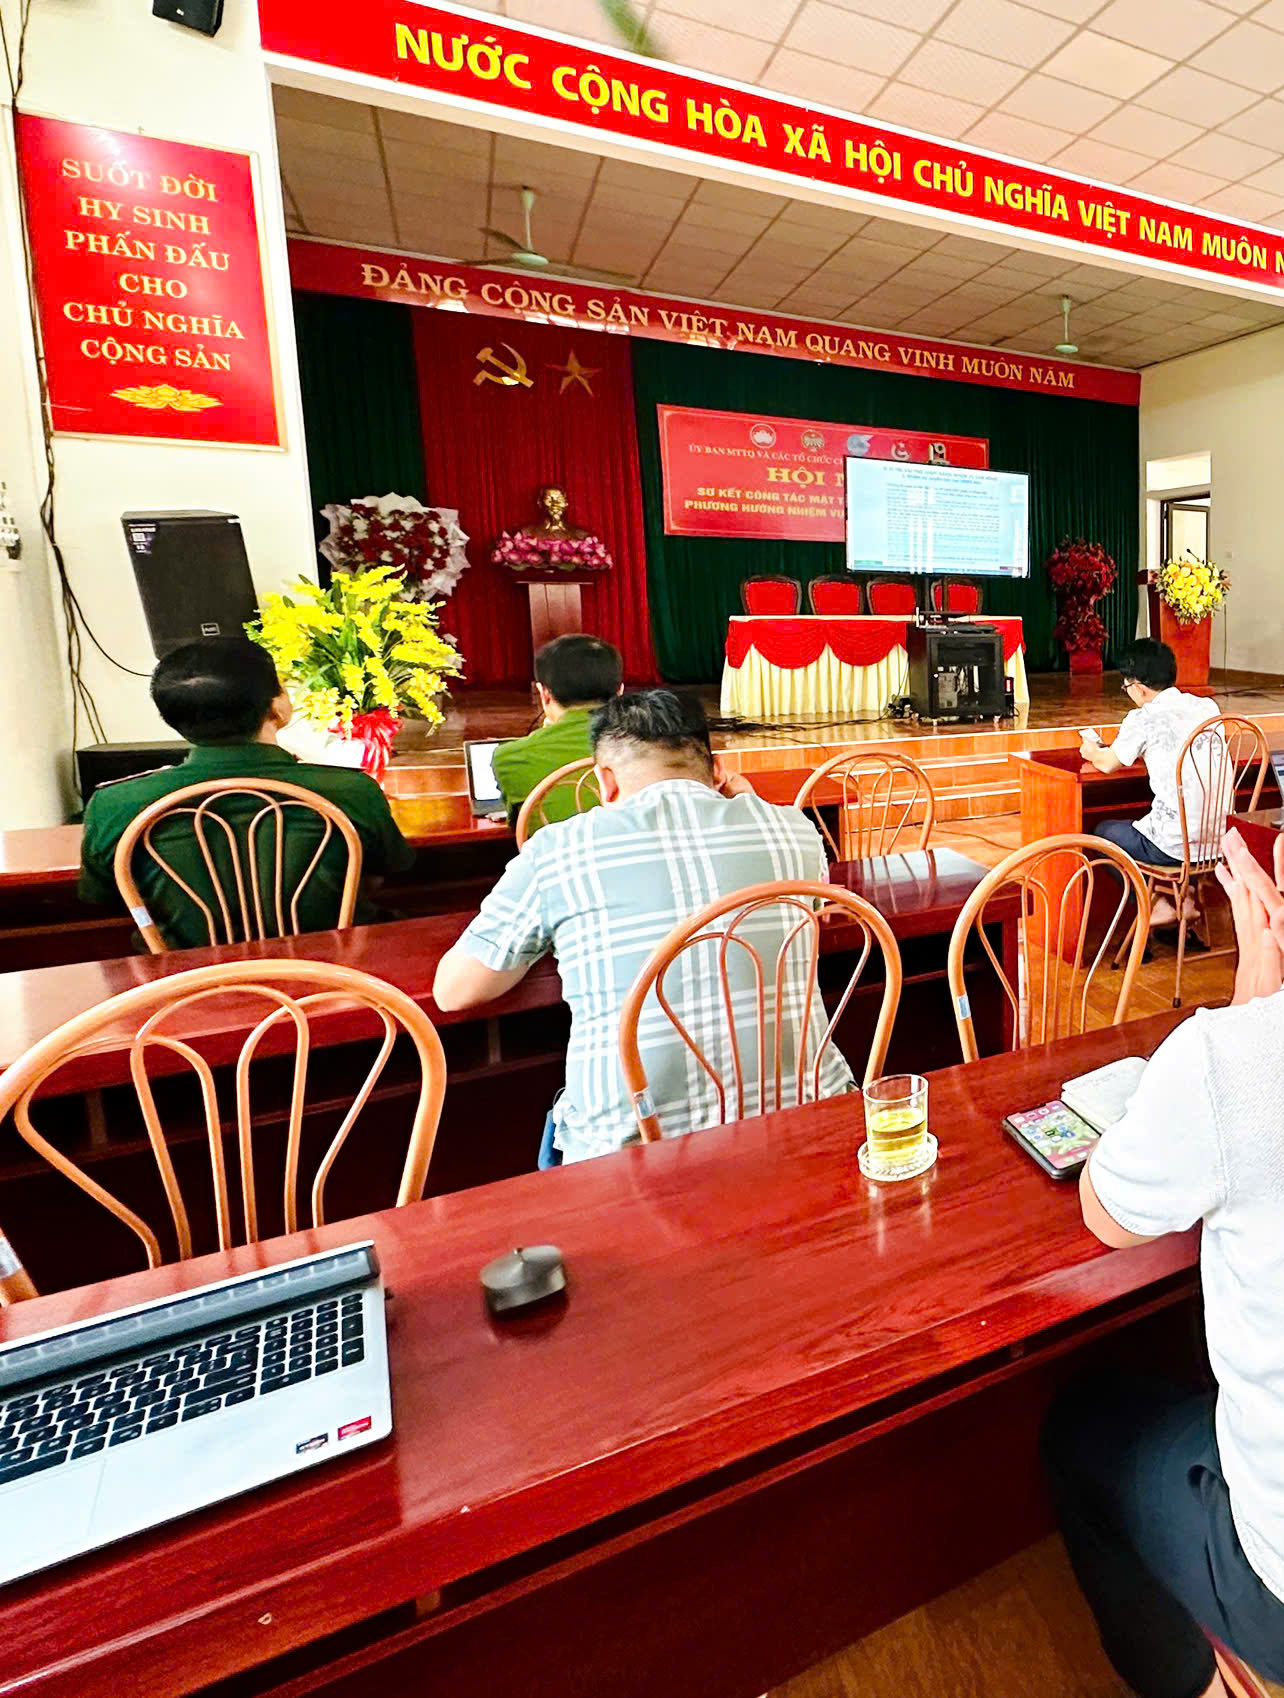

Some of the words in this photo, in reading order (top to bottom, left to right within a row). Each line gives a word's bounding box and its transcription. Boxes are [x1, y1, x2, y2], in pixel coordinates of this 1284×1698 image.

[395, 23, 532, 89] NƯỚC
[552, 64, 669, 123] CỘNG
[686, 98, 767, 148] HÒA
[782, 123, 831, 163] XÃ
[845, 139, 902, 184] HỘI
[913, 159, 974, 197] CHỦ
[984, 175, 1069, 222] NGHĨA
[1078, 201, 1131, 239] VIỆT
[1139, 216, 1193, 252] NAM
[1202, 232, 1267, 270] MUÔN
[62, 158, 149, 190] SUỐT
[160, 174, 219, 202] ĐỜI
[79, 196, 124, 221] HY
[133, 205, 211, 235] SINH
[64, 230, 155, 262] PHẤN
[164, 242, 231, 271] ĐẤU
[119, 273, 188, 299] CHO
[63, 301, 133, 327] CHỦ
[143, 311, 245, 340] NGHĨA
[361, 262, 470, 299] ĐẢNG
[481, 281, 577, 317] CỘNG
[586, 296, 650, 326] SẢN
[735, 322, 798, 349] NAM
[805, 333, 891, 363] QUANG
[897, 347, 955, 372] VINH
[961, 356, 1024, 381] MUÔN
[1029, 366, 1075, 389] NĂM
[80, 337, 169, 365] CỘNG
[175, 344, 232, 371] SẢN
[767, 466, 825, 488] HỘI
